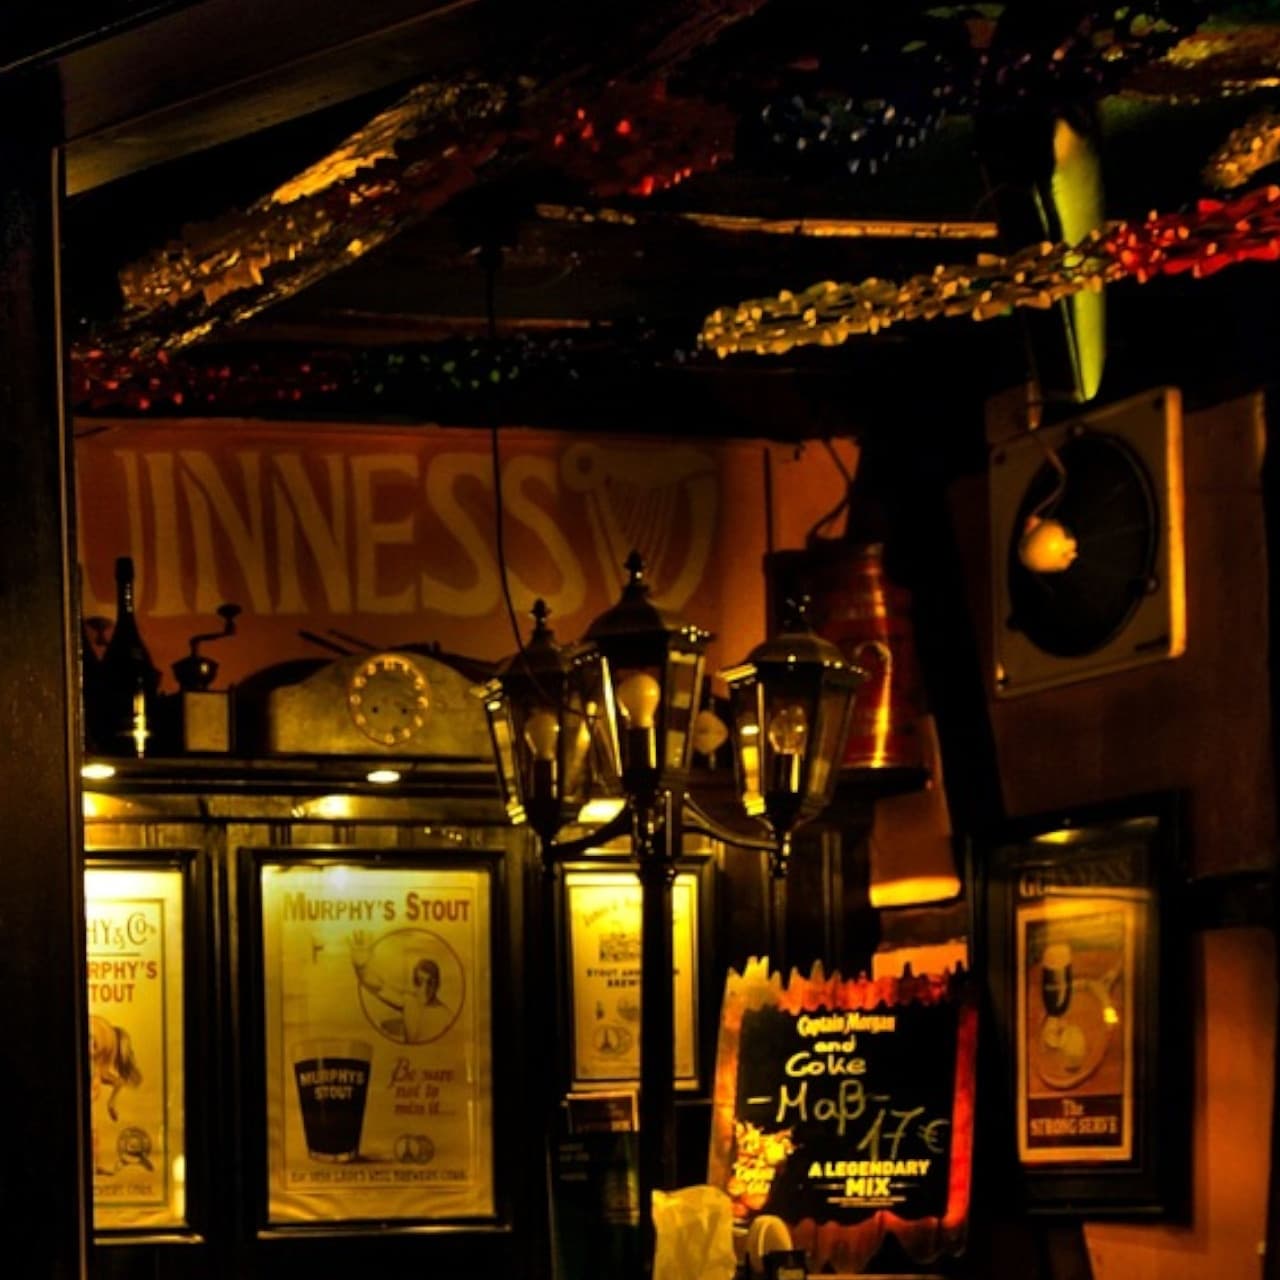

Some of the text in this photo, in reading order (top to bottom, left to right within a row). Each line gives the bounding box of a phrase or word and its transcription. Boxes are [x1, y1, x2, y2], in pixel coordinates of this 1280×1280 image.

[282, 891, 471, 923] MURPHY'S STOUT
[813, 1034, 857, 1054] and
[785, 1051, 867, 1078] Coke
[807, 1159, 931, 1179] A LEGENDARY
[845, 1178, 891, 1198] MIX
